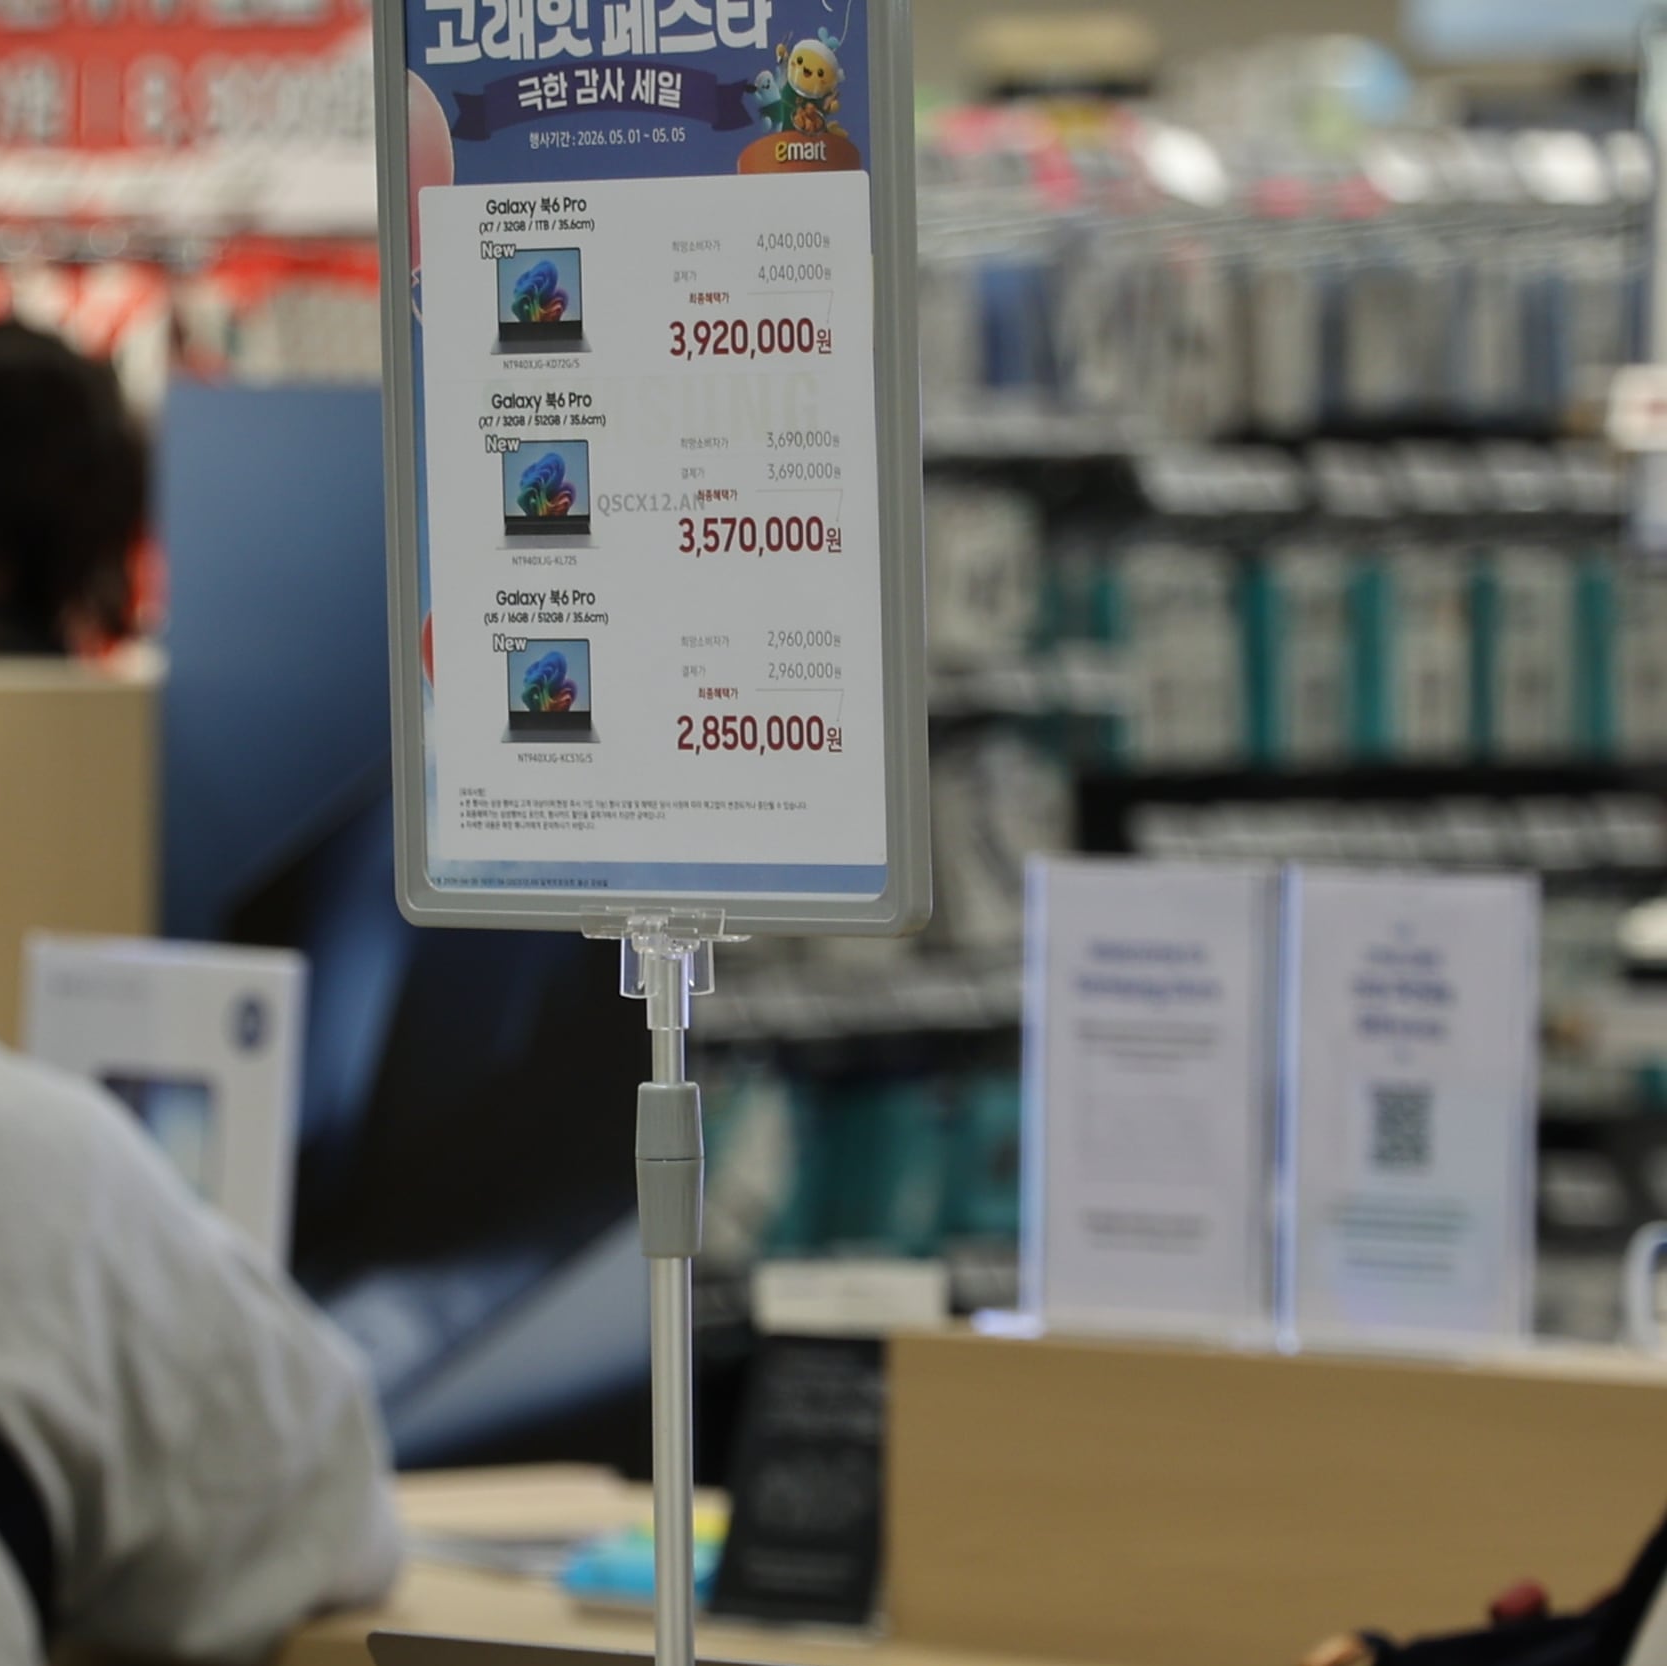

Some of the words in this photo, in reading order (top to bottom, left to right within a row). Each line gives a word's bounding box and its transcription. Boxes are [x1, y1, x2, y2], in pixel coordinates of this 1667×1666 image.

[425, 0, 592, 64] 고래잇
[602, 0, 772, 54] 페스타
[518, 75, 568, 111] 극한
[575, 67, 624, 106] 감사
[631, 66, 682, 108] 세일
[775, 141, 827, 162] emart
[486, 199, 536, 217] Galaxy
[540, 198, 560, 215] 북6
[563, 197, 587, 213] Pro
[480, 240, 516, 259] New
[669, 317, 833, 361] 3,920,000원
[491, 393, 542, 413] Galaxy
[545, 392, 566, 409] 북6
[568, 391, 593, 408] Pro
[485, 434, 522, 453] New
[678, 516, 842, 558] 3,570,000원
[496, 590, 546, 610] Galaxy
[549, 589, 570, 606] 북6
[572, 589, 595, 606] Pro
[492, 633, 528, 652] New
[677, 715, 843, 756] 2,850,000원
